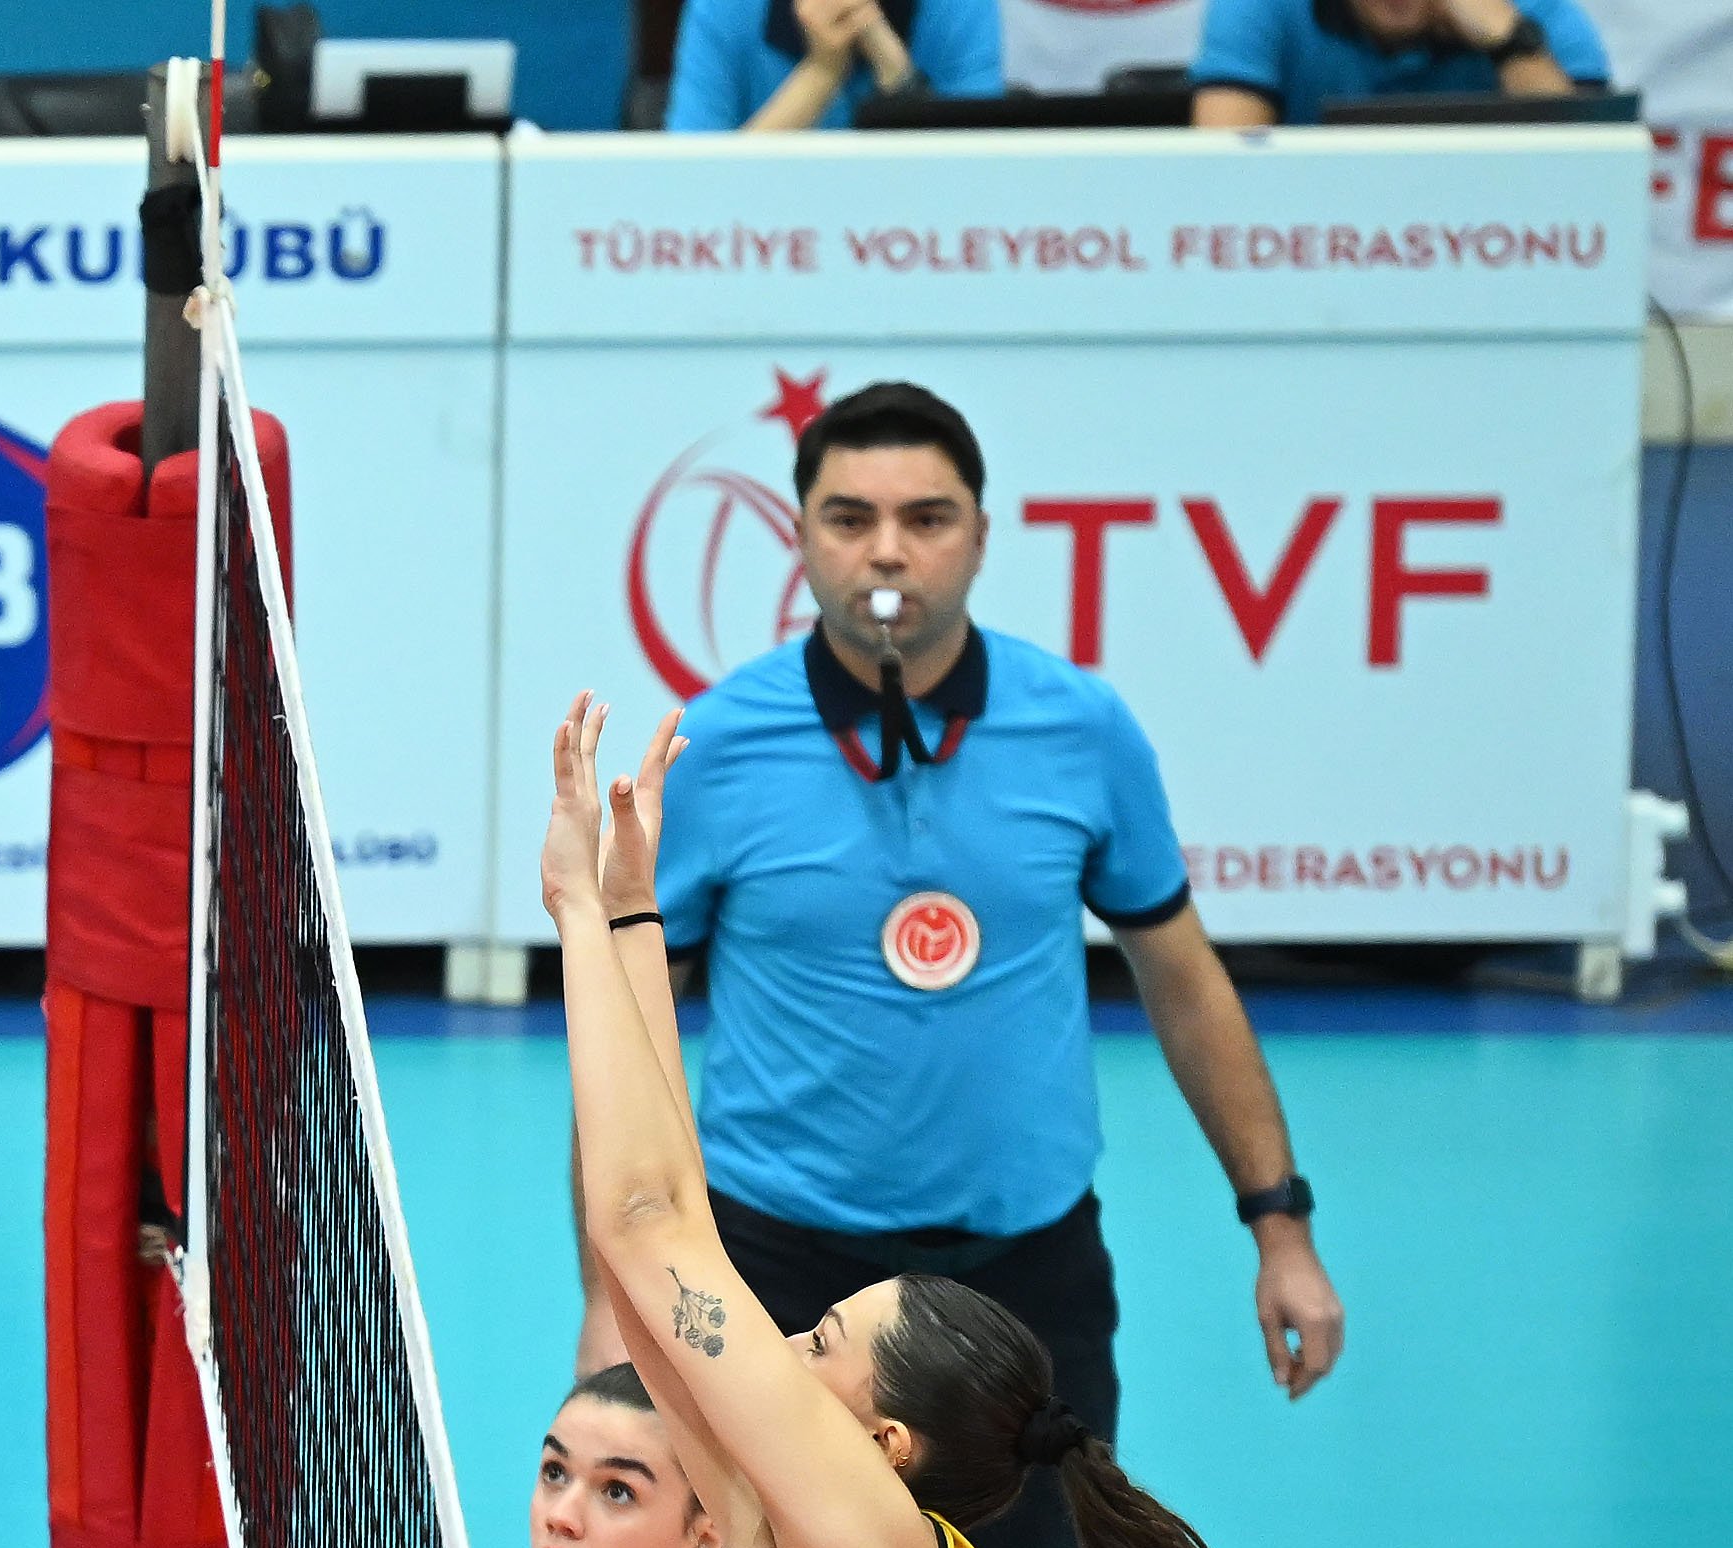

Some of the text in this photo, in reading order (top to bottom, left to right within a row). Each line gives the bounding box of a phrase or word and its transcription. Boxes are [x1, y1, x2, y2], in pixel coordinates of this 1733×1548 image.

[572, 217, 1607, 273] TÜRKİYE VOLEYBOL FEDERASYONU
[1022, 495, 1503, 668] TVF
[1183, 845, 1570, 891] EDERASYONU
